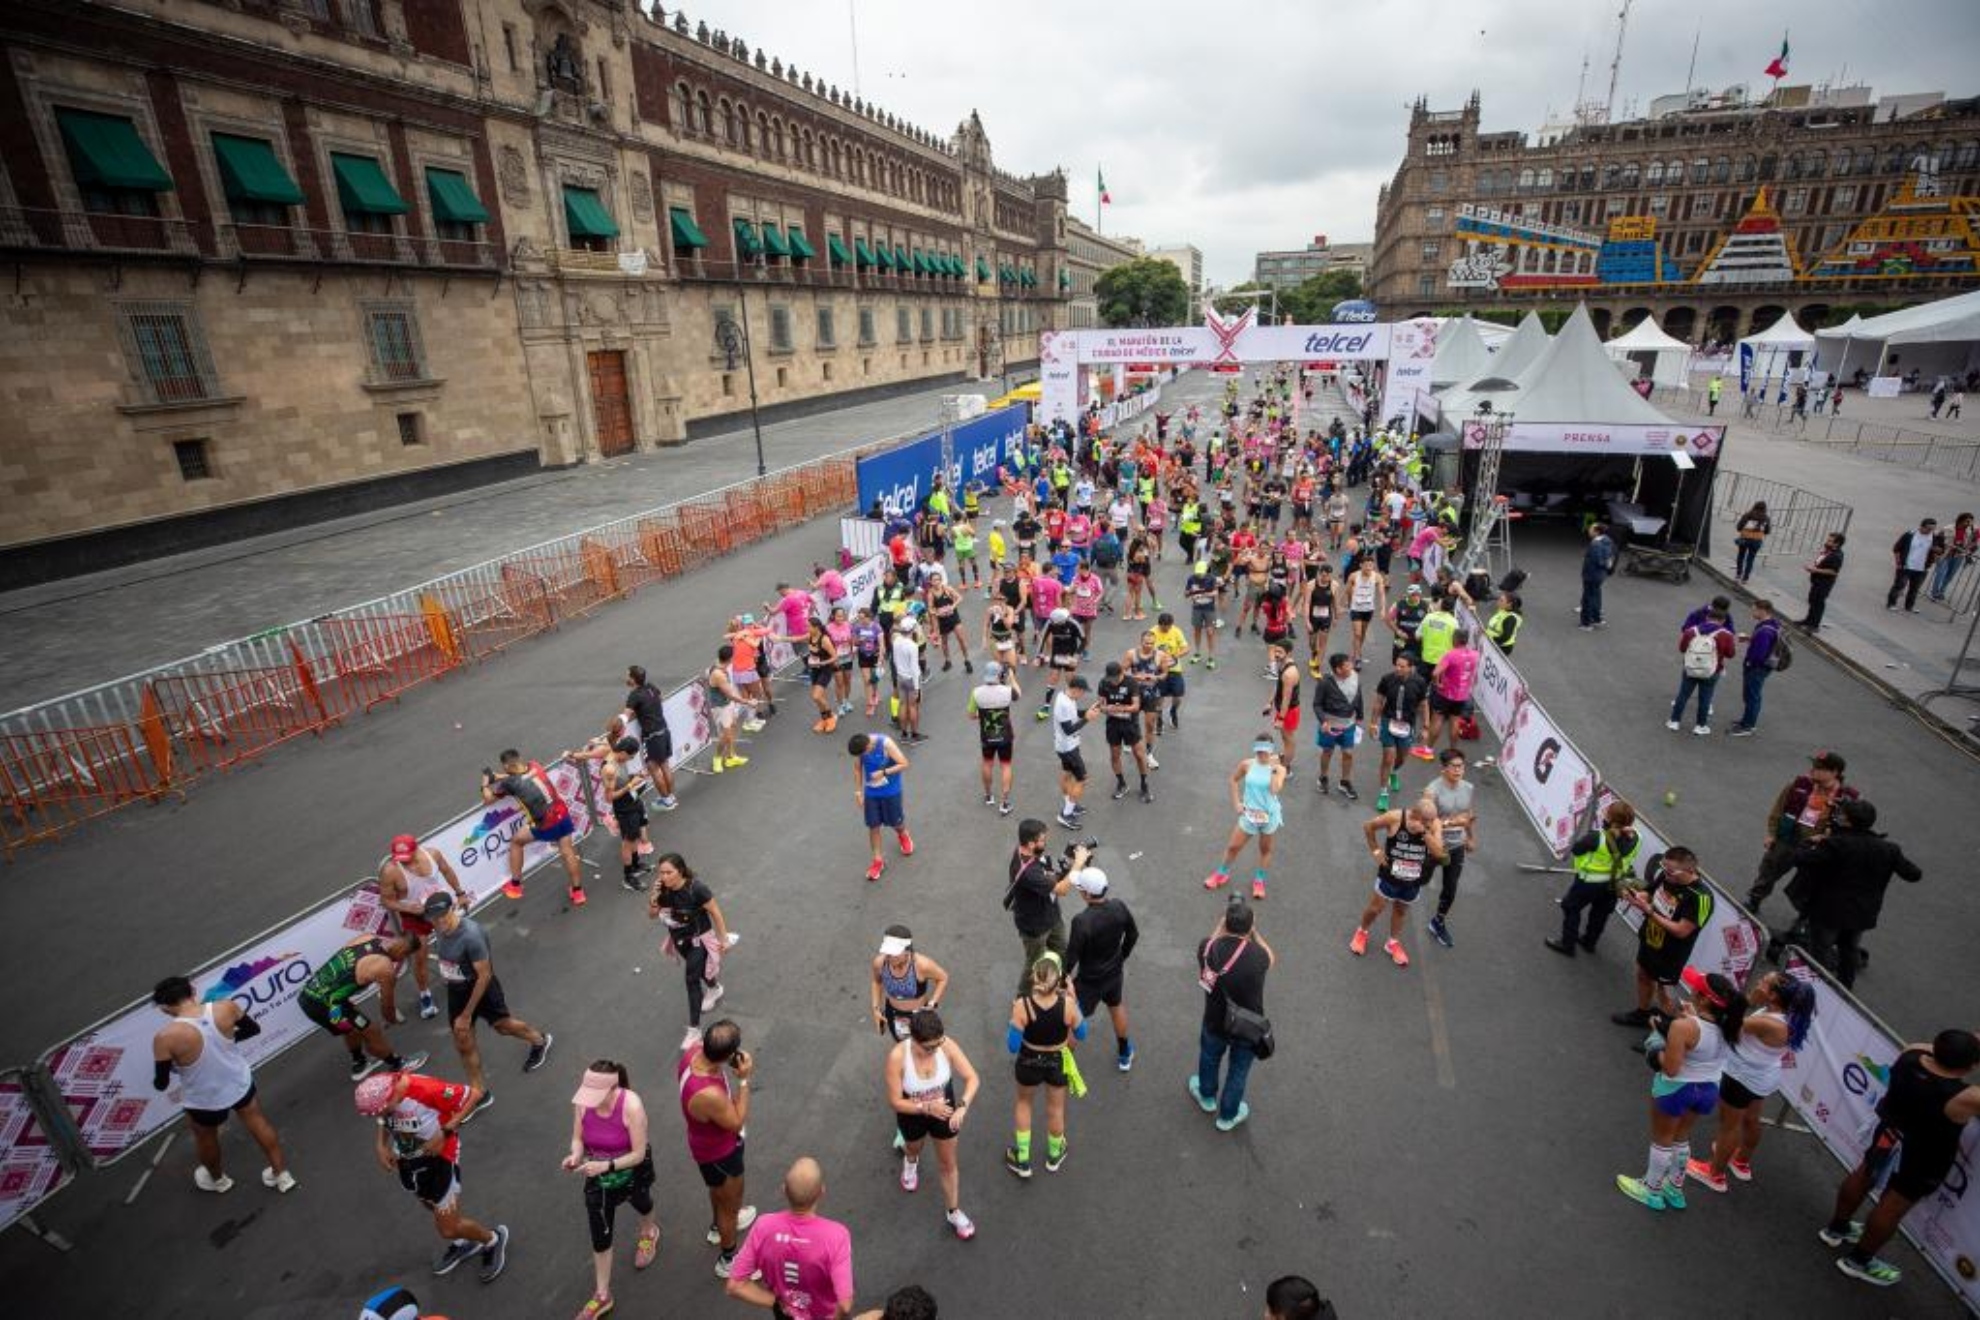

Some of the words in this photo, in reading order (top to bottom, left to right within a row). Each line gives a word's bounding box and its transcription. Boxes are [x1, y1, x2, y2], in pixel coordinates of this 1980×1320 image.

[1305, 332, 1373, 353] telcel
[1563, 432, 1611, 443] PRENSA
[851, 569, 878, 597] BBVA
[1483, 656, 1508, 701] BBVA
[1533, 737, 1562, 785] G
